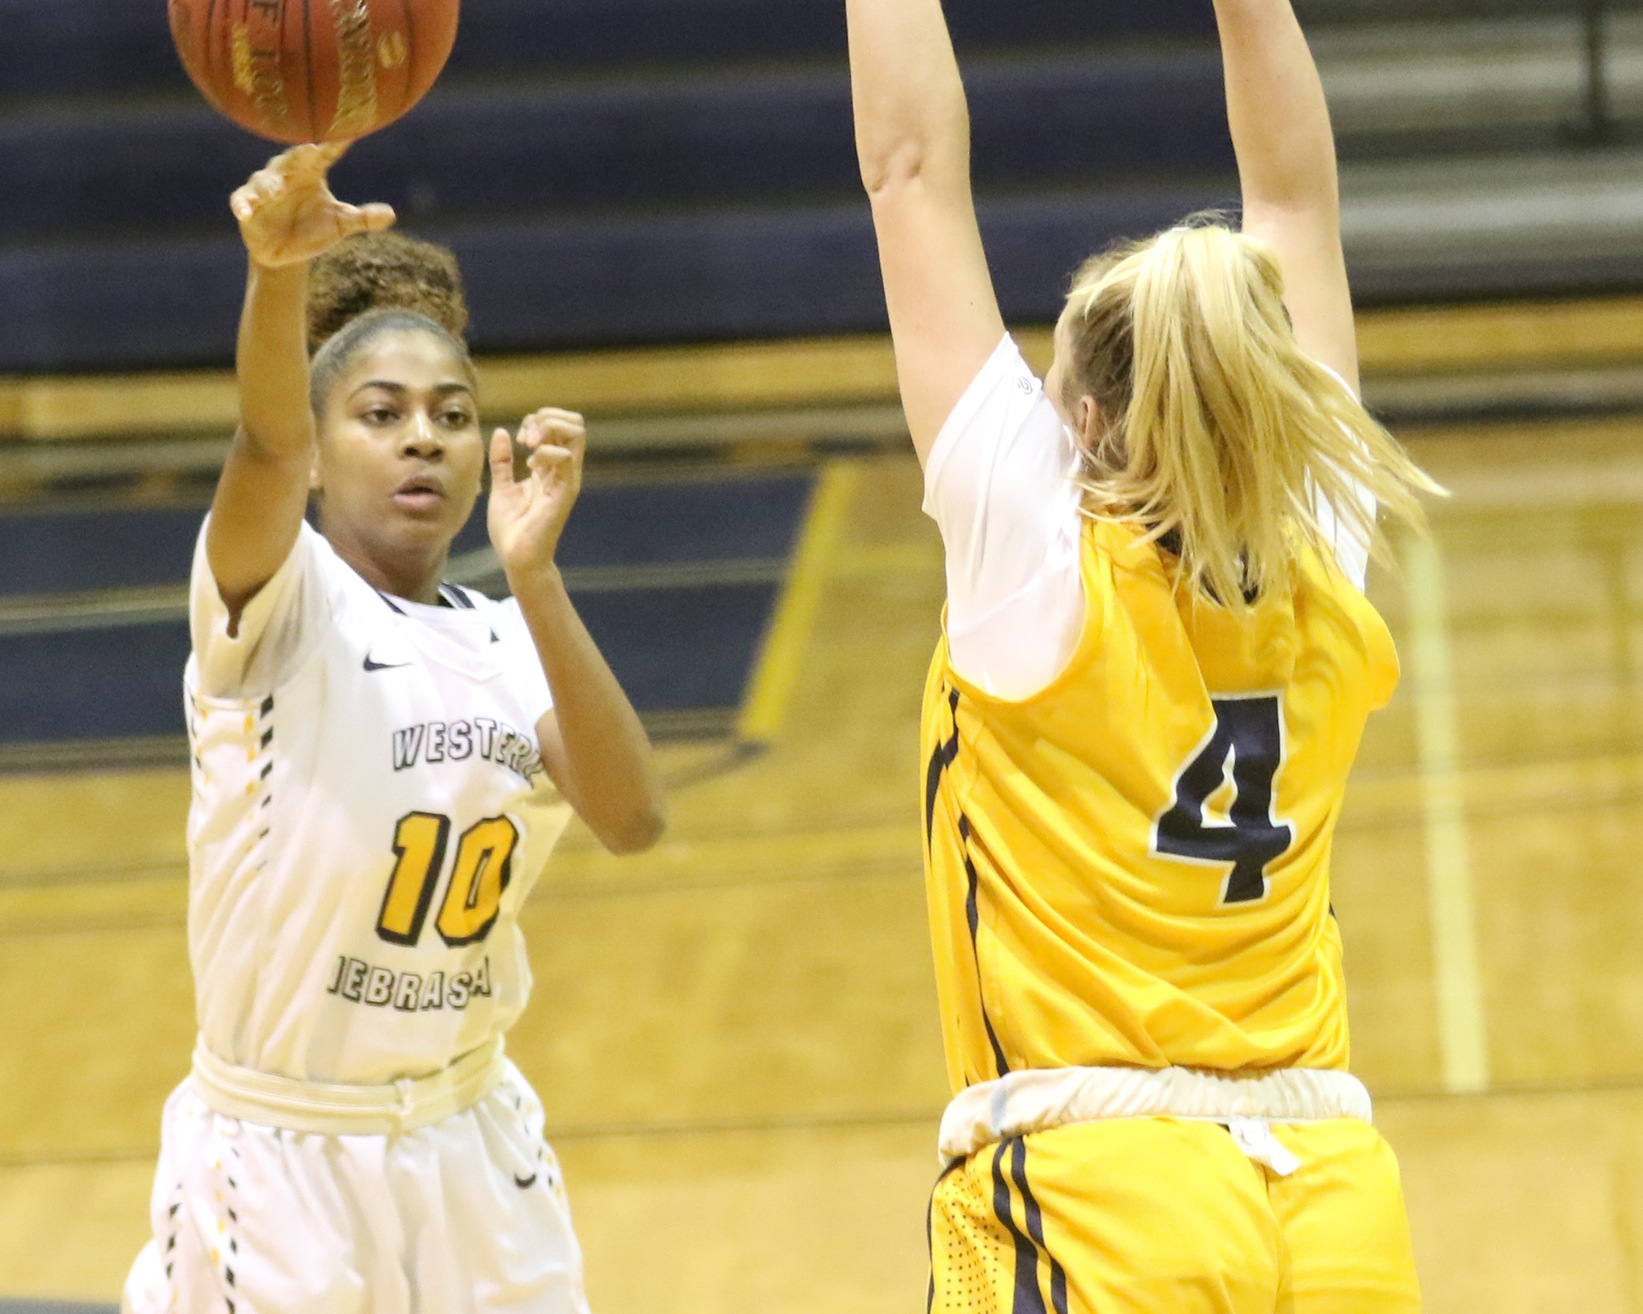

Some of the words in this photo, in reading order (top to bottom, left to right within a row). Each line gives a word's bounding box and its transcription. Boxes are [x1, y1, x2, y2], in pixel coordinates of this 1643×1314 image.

[1147, 690, 1296, 909] 4
[375, 811, 519, 948] 10
[327, 954, 492, 1012] EBRASA
